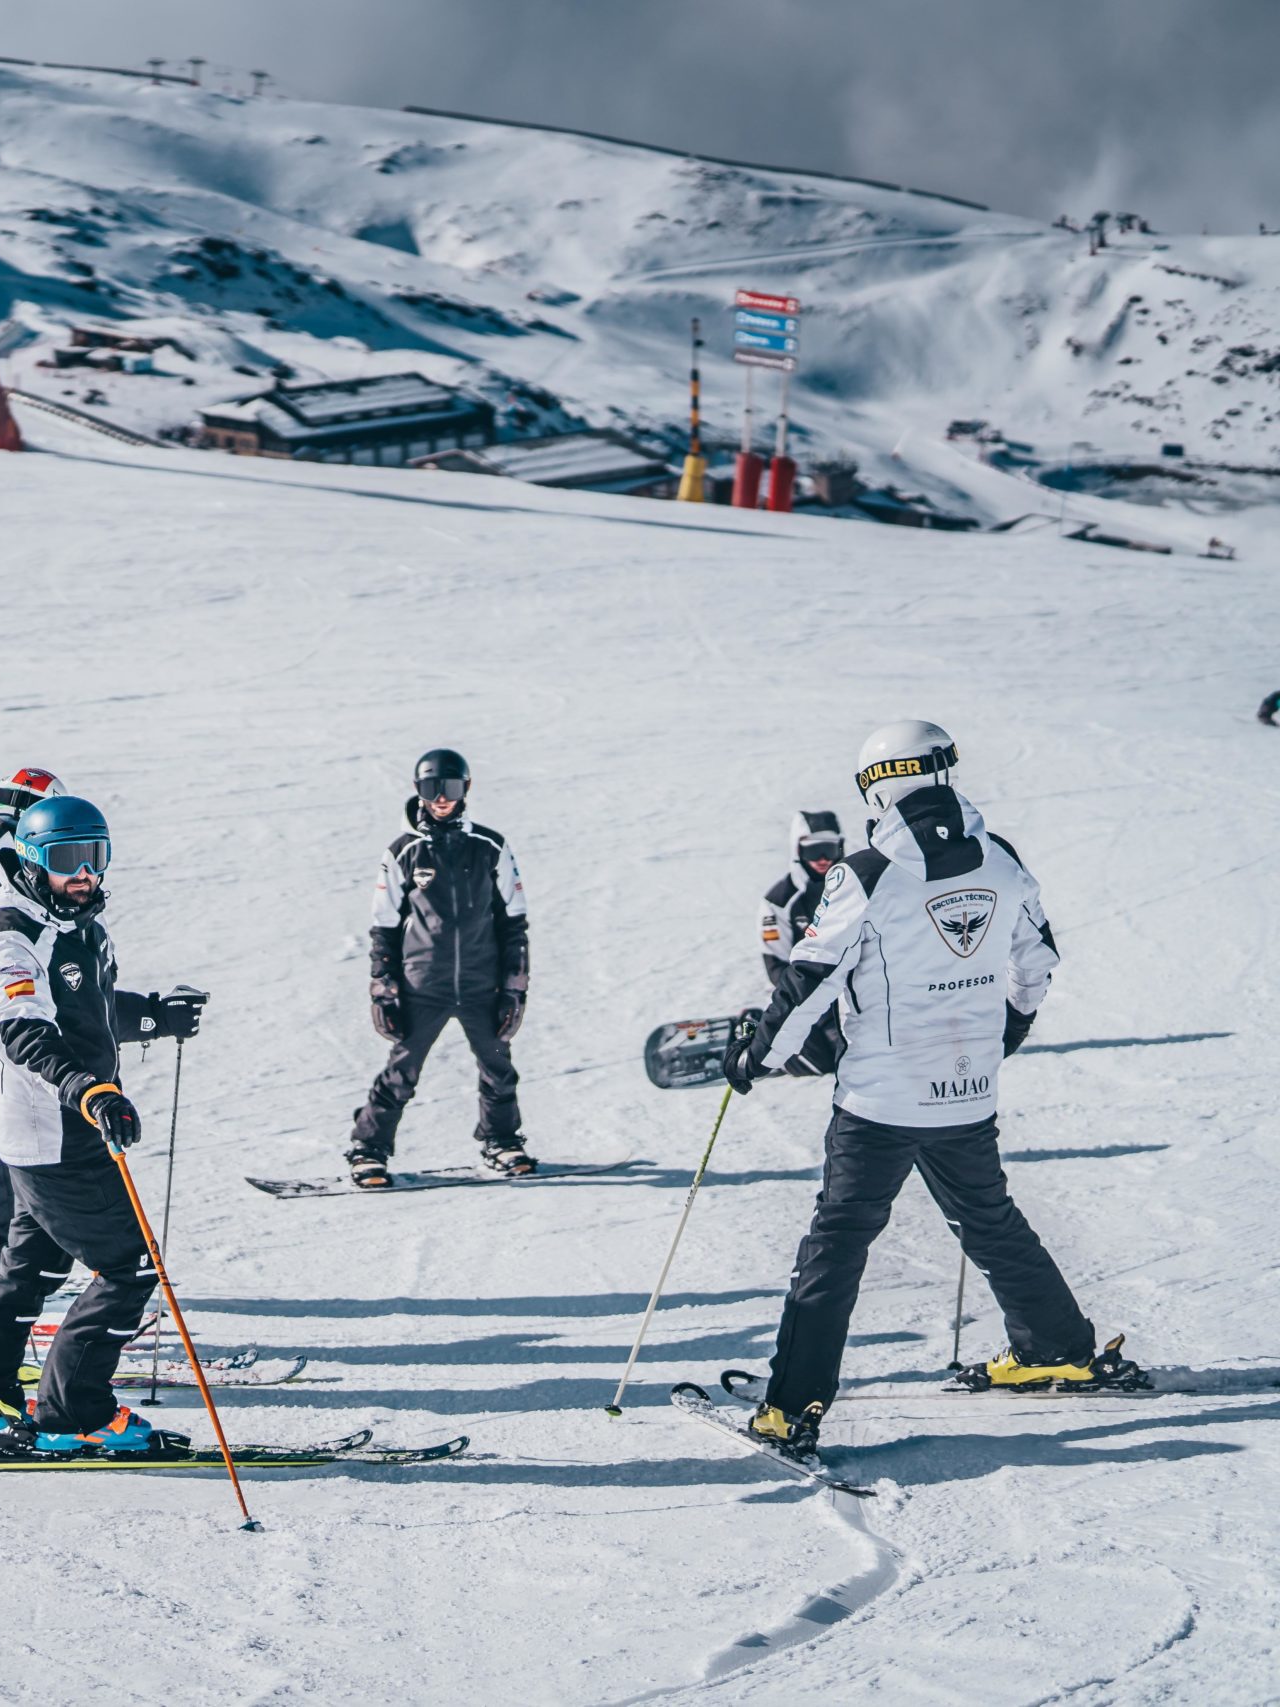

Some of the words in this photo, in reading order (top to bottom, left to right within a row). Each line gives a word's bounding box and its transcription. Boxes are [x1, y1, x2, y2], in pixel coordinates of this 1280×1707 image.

[867, 759, 922, 781] ULLER
[931, 895, 964, 911] ESCUELA
[965, 893, 994, 903] TÉCNICA
[928, 974, 995, 992] PROFESOR
[929, 1075, 989, 1099] MAJAO
